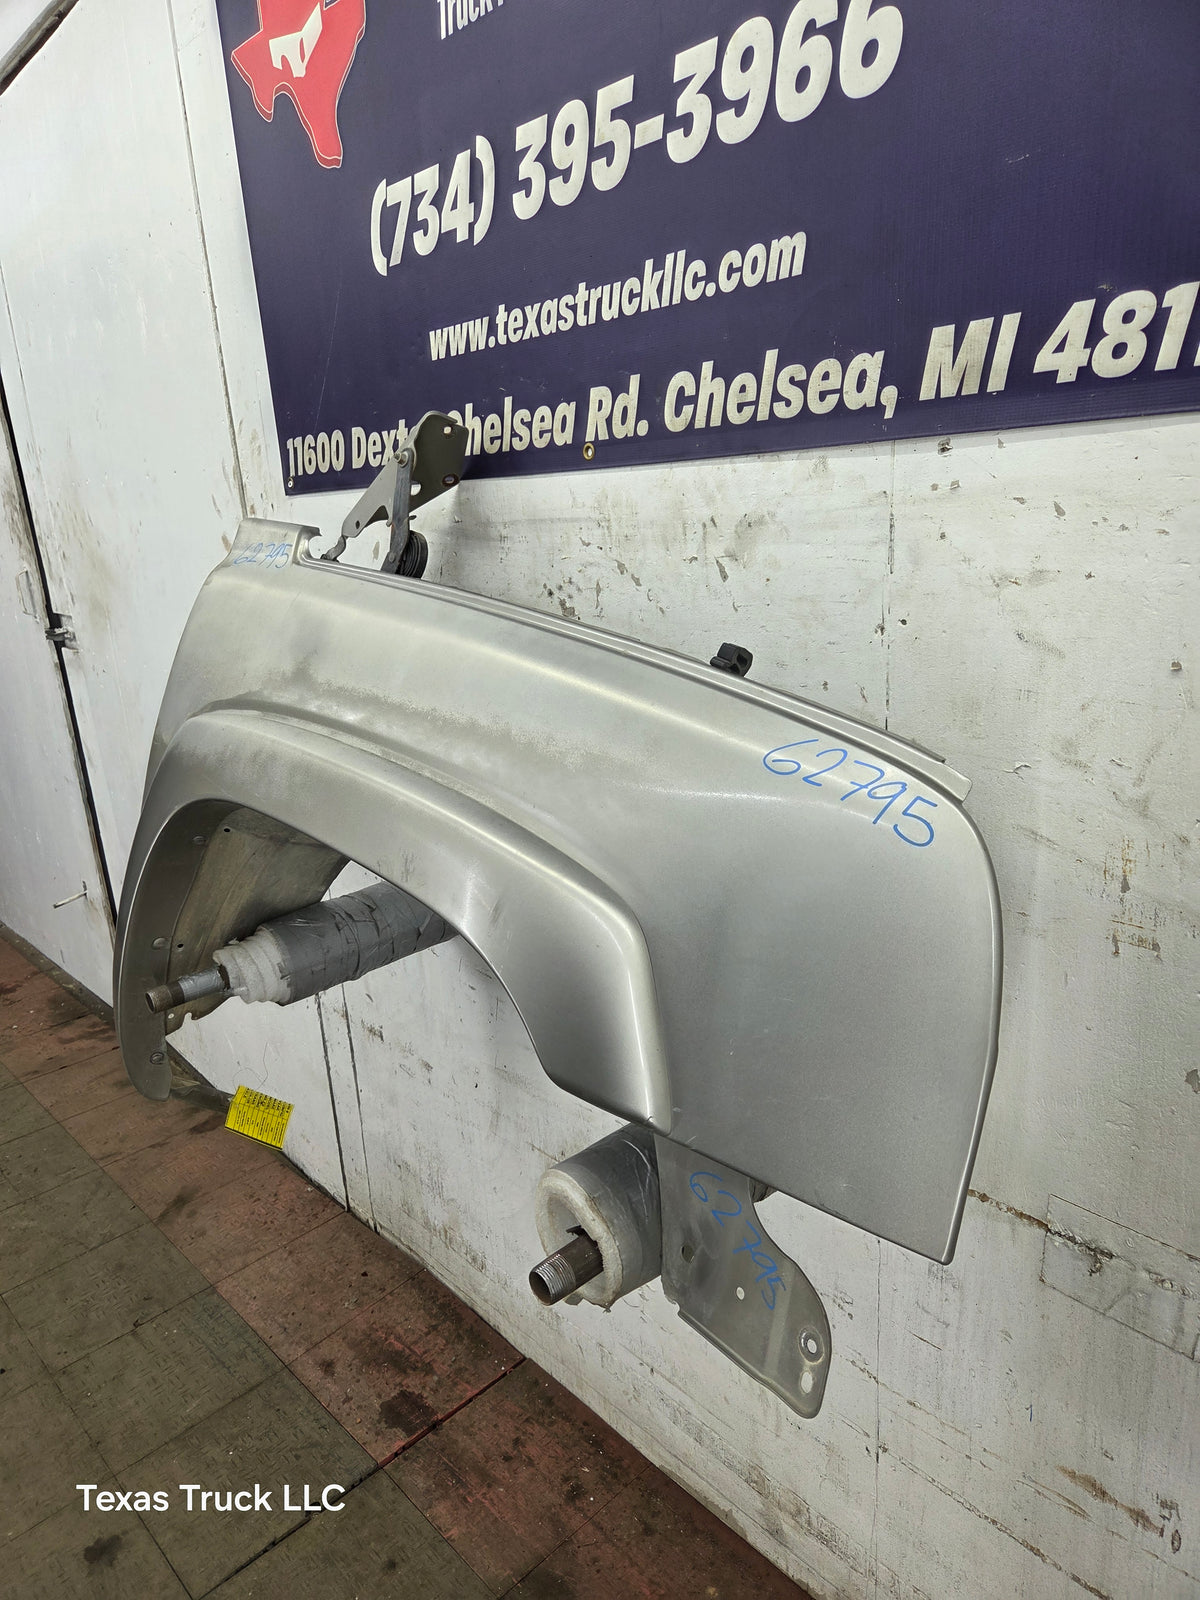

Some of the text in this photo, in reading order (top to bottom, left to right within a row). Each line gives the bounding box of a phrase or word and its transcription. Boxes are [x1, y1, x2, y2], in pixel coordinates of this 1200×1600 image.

[370, 0, 904, 277] (734) 395-3966
[429, 231, 807, 361] www.texastruckllc.com
[286, 429, 346, 476] 11600
[585, 373, 649, 442] Rd.
[664, 349, 899, 433] Chelsea,
[919, 312, 1022, 402] MI
[1033, 281, 1200, 384] 481
[233, 542, 293, 569] 62795
[763, 739, 937, 847] 62795
[689, 1172, 787, 1310] 62795
